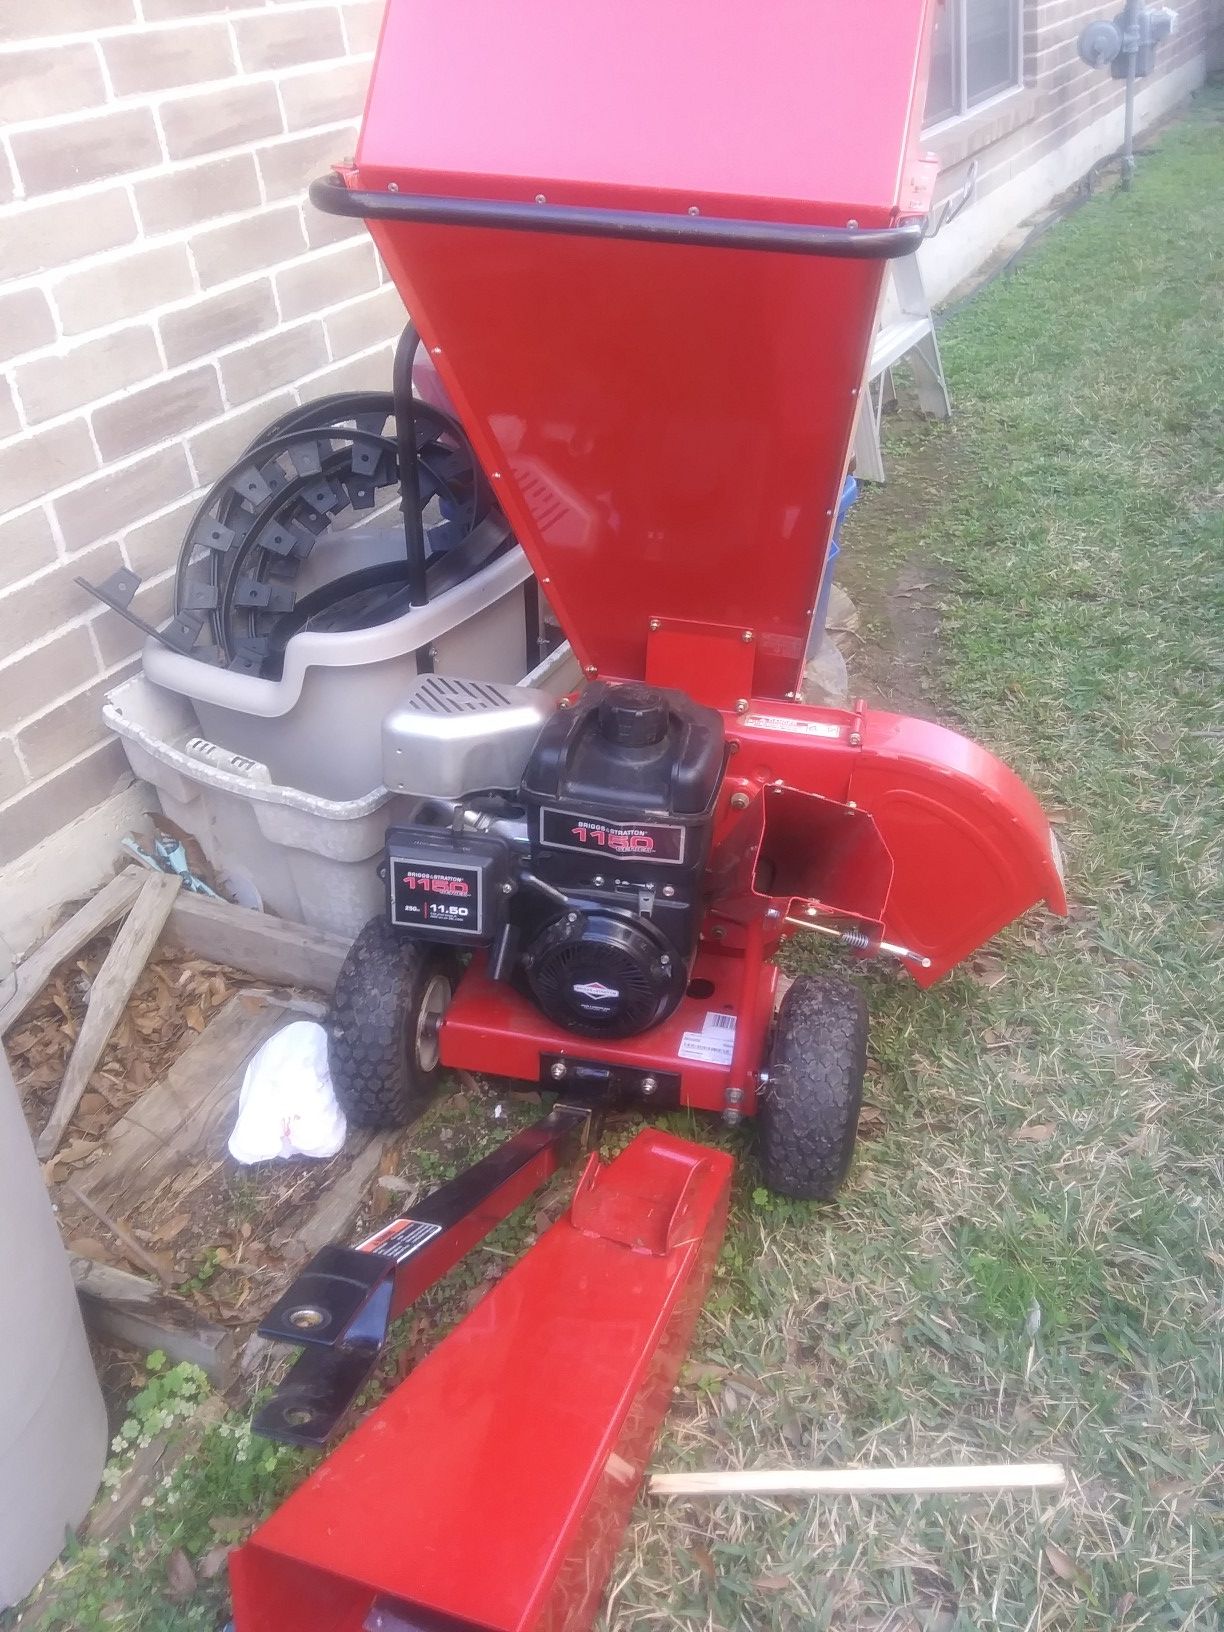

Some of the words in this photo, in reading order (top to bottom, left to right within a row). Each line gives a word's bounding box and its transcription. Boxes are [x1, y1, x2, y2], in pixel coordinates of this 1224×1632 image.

[571, 827, 654, 850] 1150
[403, 876, 469, 895] 1150
[430, 904, 468, 916] 11.50
